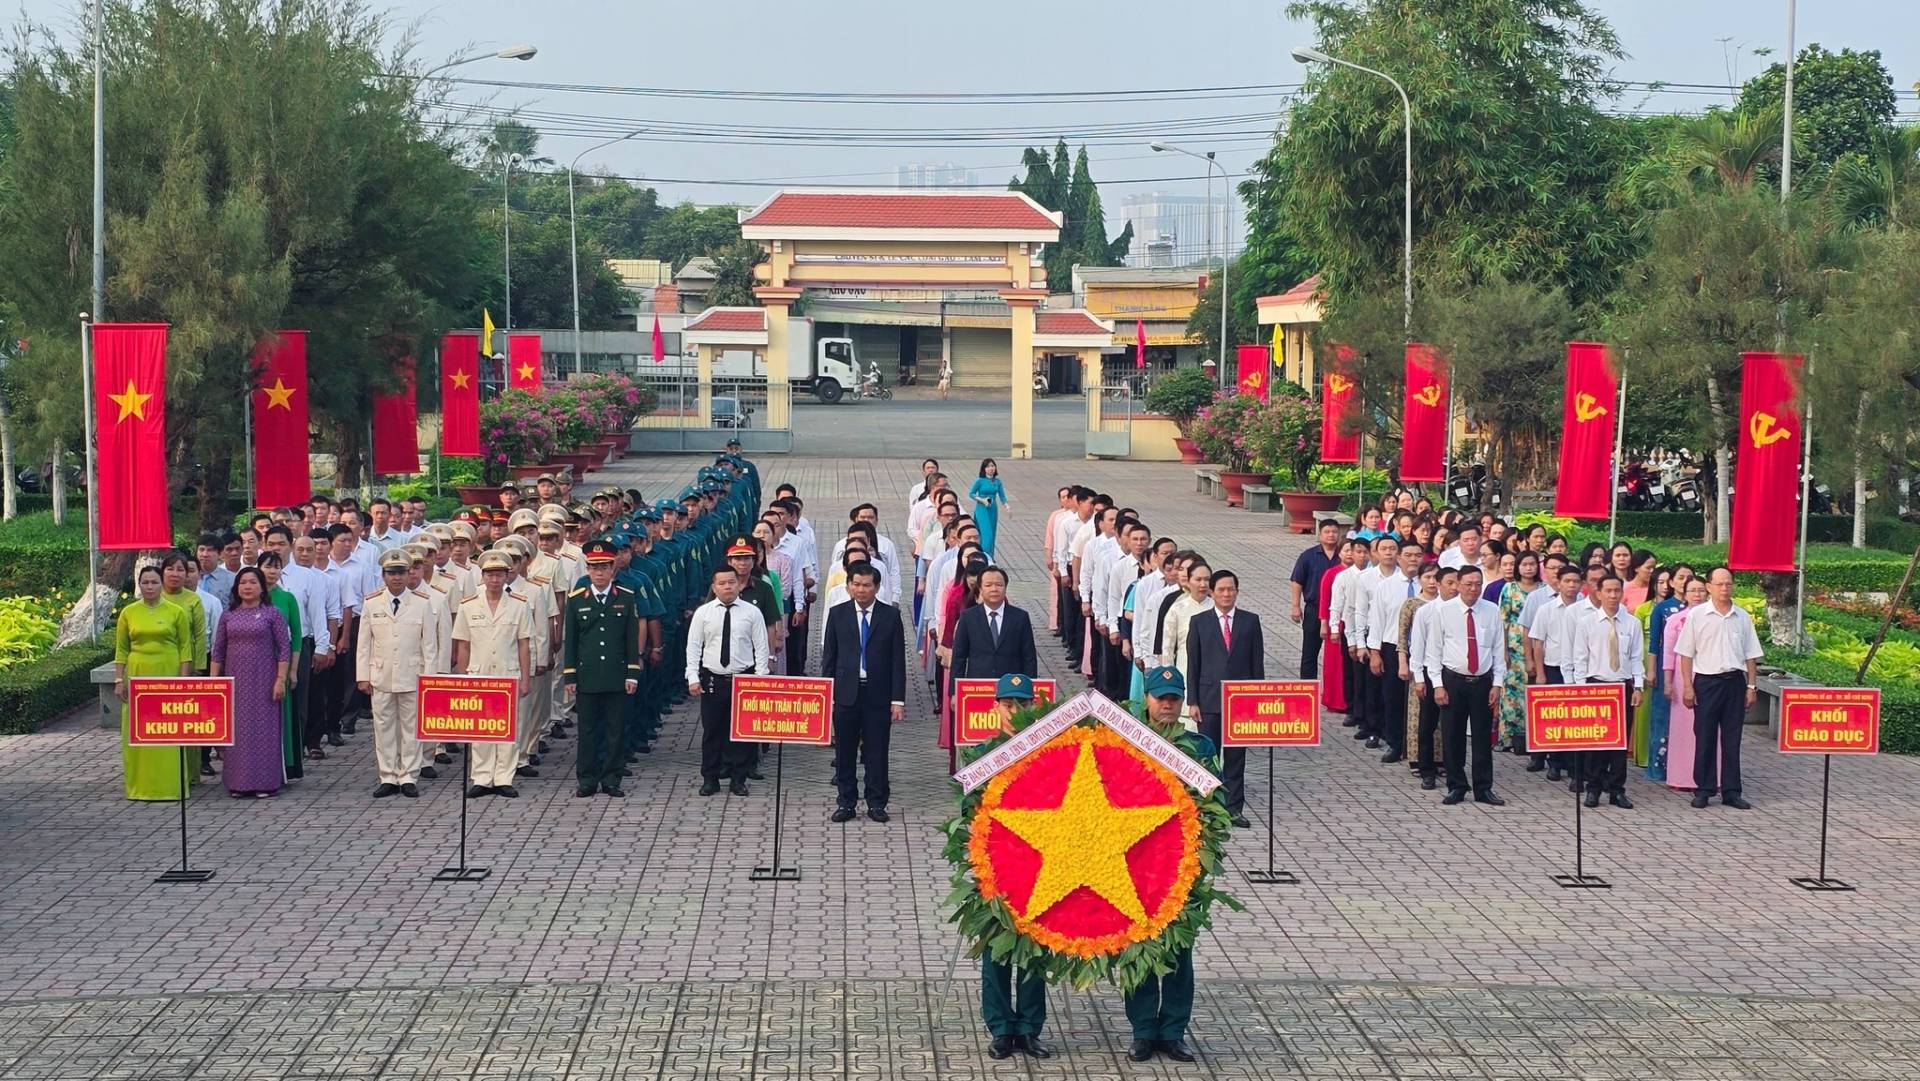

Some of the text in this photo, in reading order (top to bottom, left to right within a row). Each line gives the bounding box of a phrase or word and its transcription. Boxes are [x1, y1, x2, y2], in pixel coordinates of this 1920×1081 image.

[161, 698, 199, 714] KHỐI
[450, 695, 483, 711] KHỐI
[743, 696, 758, 711] KHỐI
[759, 697, 773, 715] MẶT
[775, 698, 792, 716] TRẬN
[803, 698, 820, 715] QUỐC
[1258, 698, 1285, 714] KHỐI
[1540, 702, 1611, 720] KHỐI ĐƠN VỊ
[1811, 707, 1848, 723] KHỐI
[146, 718, 216, 734] KHU PHỐ
[426, 715, 506, 734] NGÀNH DỌC
[753, 717, 761, 731] VÀ
[763, 718, 776, 732] CÁC
[777, 718, 795, 733] ĐOÀN
[1233, 720, 1268, 734] CHÍNH
[1545, 723, 1608, 742] SỰ NGHIỆP
[1793, 727, 1864, 744] GIÁO DỤC
